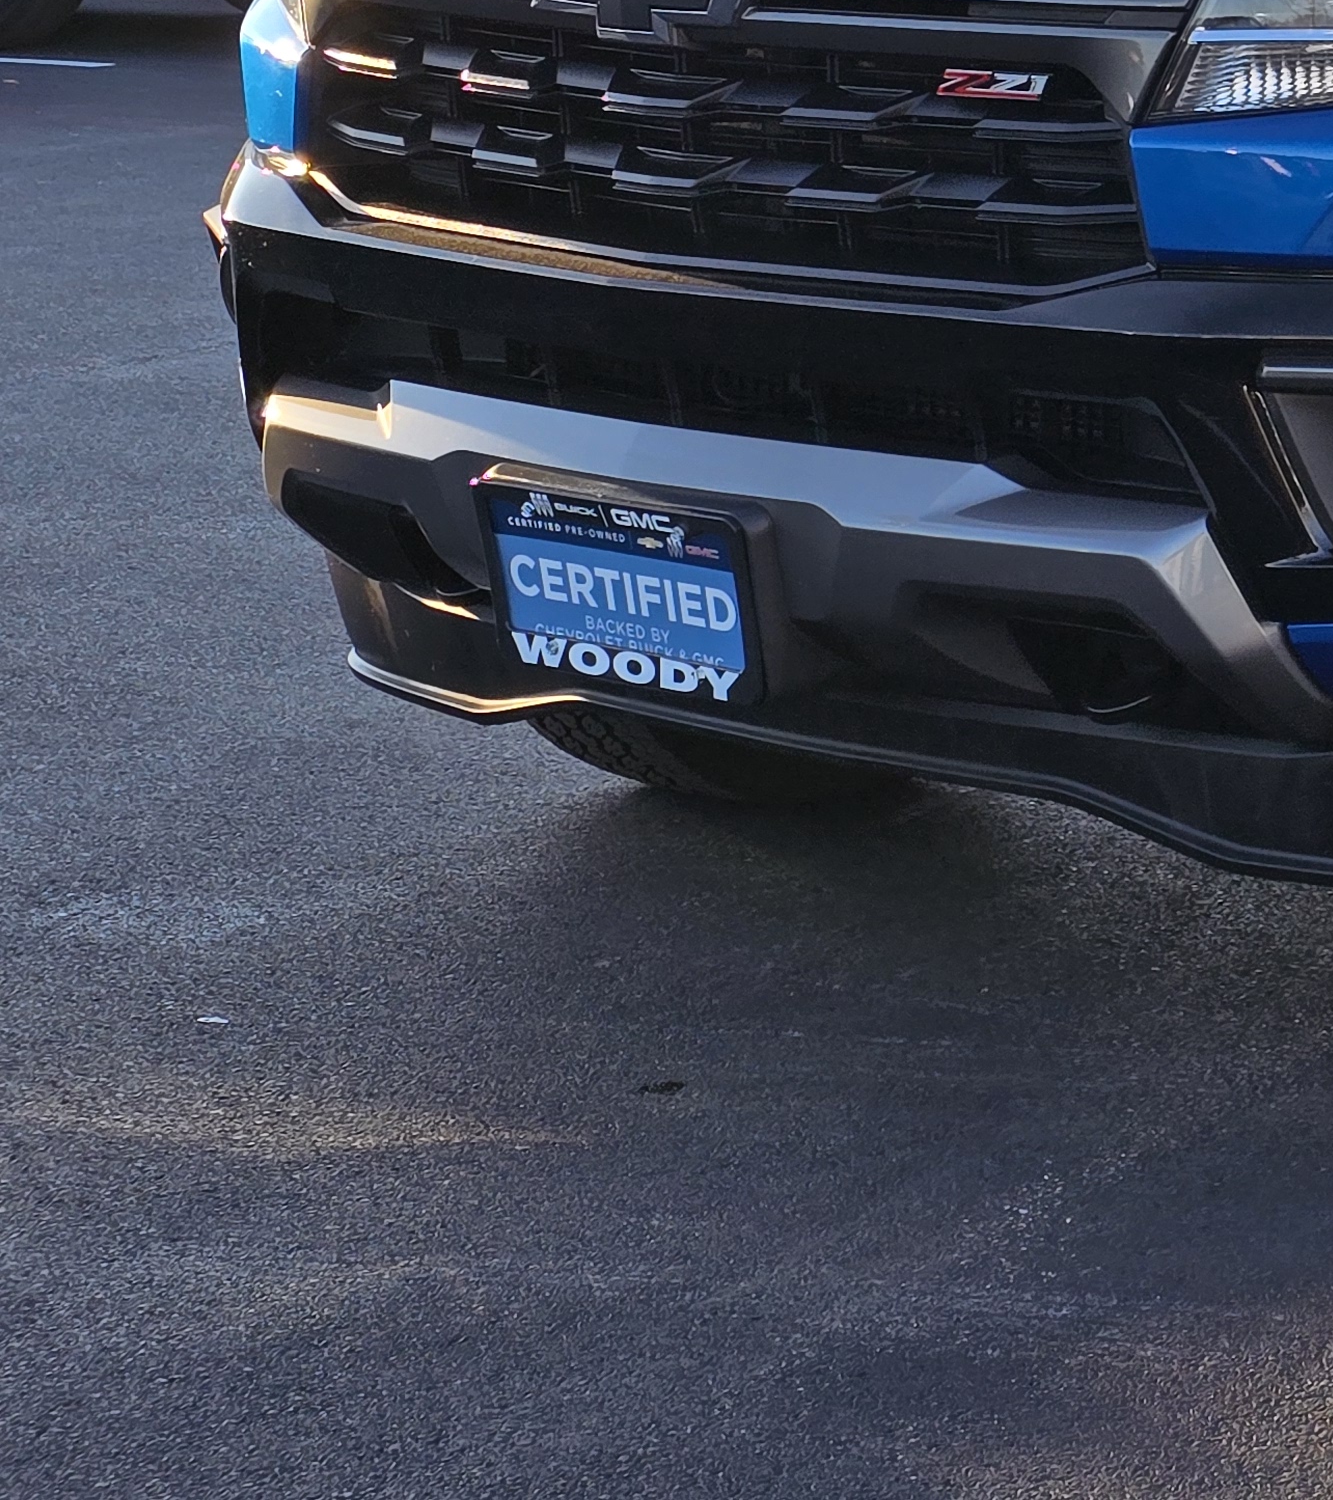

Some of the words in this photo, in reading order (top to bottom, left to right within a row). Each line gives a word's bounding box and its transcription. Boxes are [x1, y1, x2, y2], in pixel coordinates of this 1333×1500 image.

[936, 68, 1049, 101] Z71
[507, 516, 562, 532] CERTIFIED
[564, 524, 626, 544] PRE-OWNED
[553, 501, 598, 517] BUICK
[610, 508, 673, 532] GMC
[685, 544, 720, 560] GMC
[509, 554, 737, 631] CERTIFIED
[585, 615, 645, 639] BACKED
[650, 627, 671, 644] BY
[511, 631, 740, 702] WOODY
